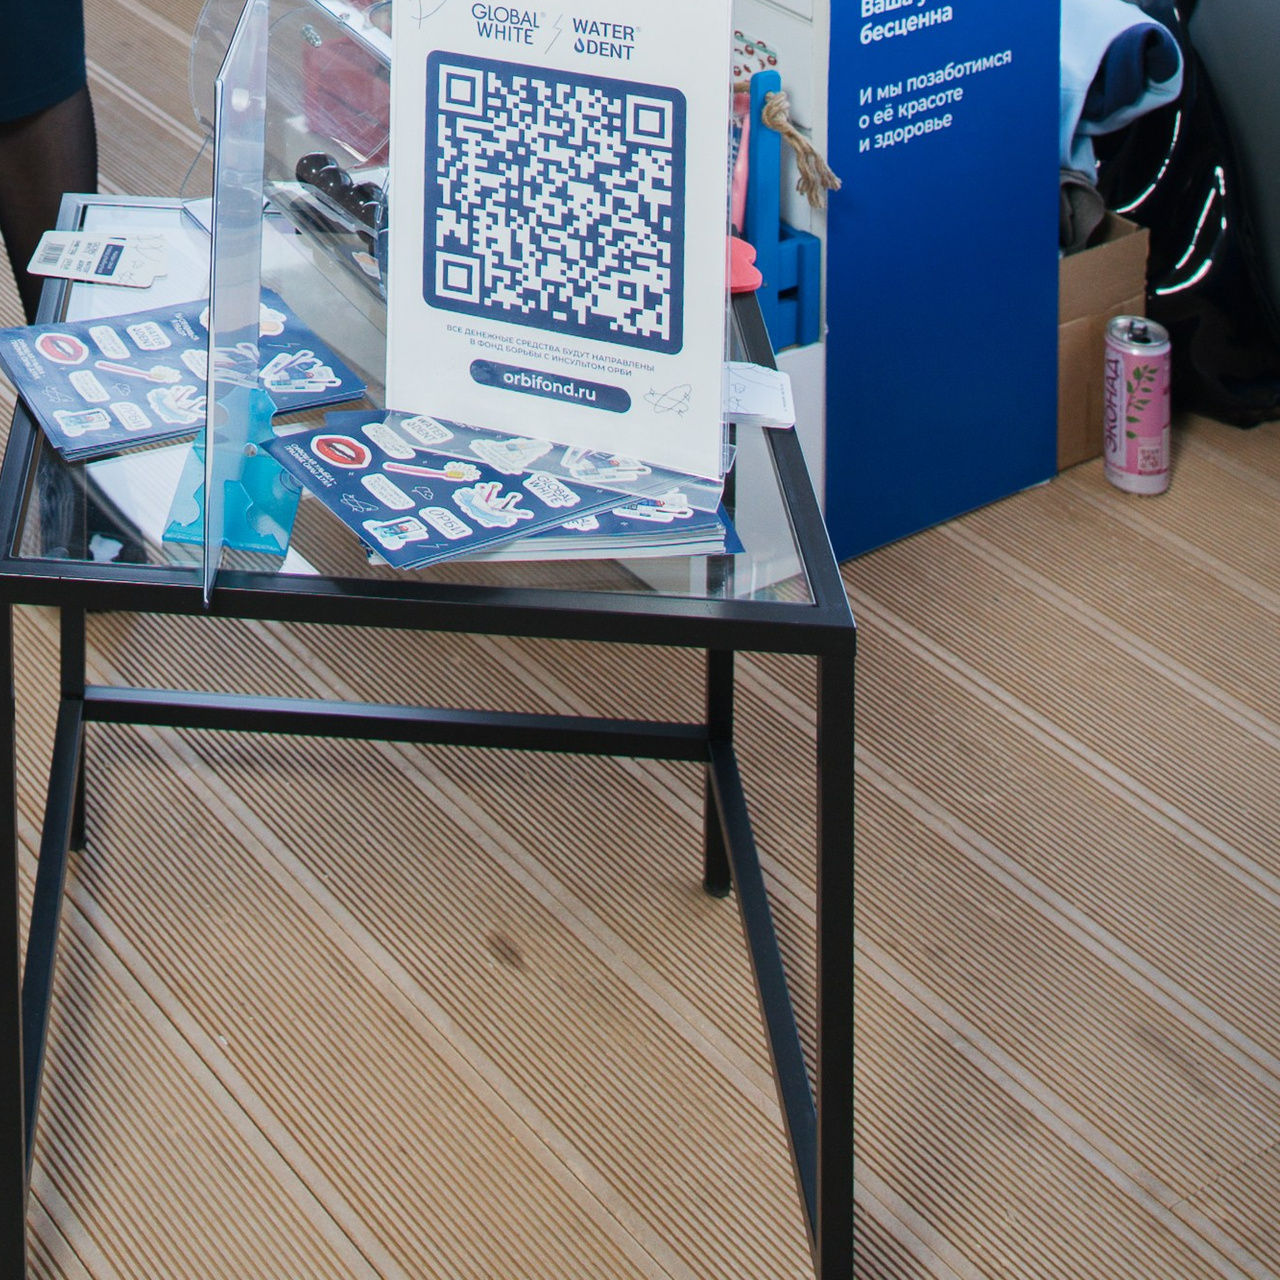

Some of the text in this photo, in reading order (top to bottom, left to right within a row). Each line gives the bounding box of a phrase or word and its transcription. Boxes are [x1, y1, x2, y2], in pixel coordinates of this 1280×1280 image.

[471, 2, 541, 29] GLOBAL
[573, 18, 635, 42] WATER
[860, 4, 954, 45] бесценна
[476, 21, 535, 45] WHITE
[587, 42, 635, 61] DENT
[859, 48, 1012, 107] И мы позаботимся
[859, 87, 964, 130] о её красоте
[859, 112, 954, 153] и здоровье
[447, 324, 655, 373] ВСЕ ДЕНЕЖНЫЕ СРЕДСТВА БУДУТ НАПРАВЛЕНЫ
[470, 337, 476, 345] В
[477, 340, 504, 352] ФОНД
[505, 345, 543, 360] БОРЬБЫ
[551, 354, 606, 372] ИНСУЛЬТОМ
[607, 365, 633, 377] ОРБИ
[503, 371, 597, 402] orbifond.ru
[418, 418, 448, 438] WATER
[529, 480, 562, 504] WHITE
[537, 474, 575, 503] GLOBAL
[428, 509, 467, 536] ОРБИ
